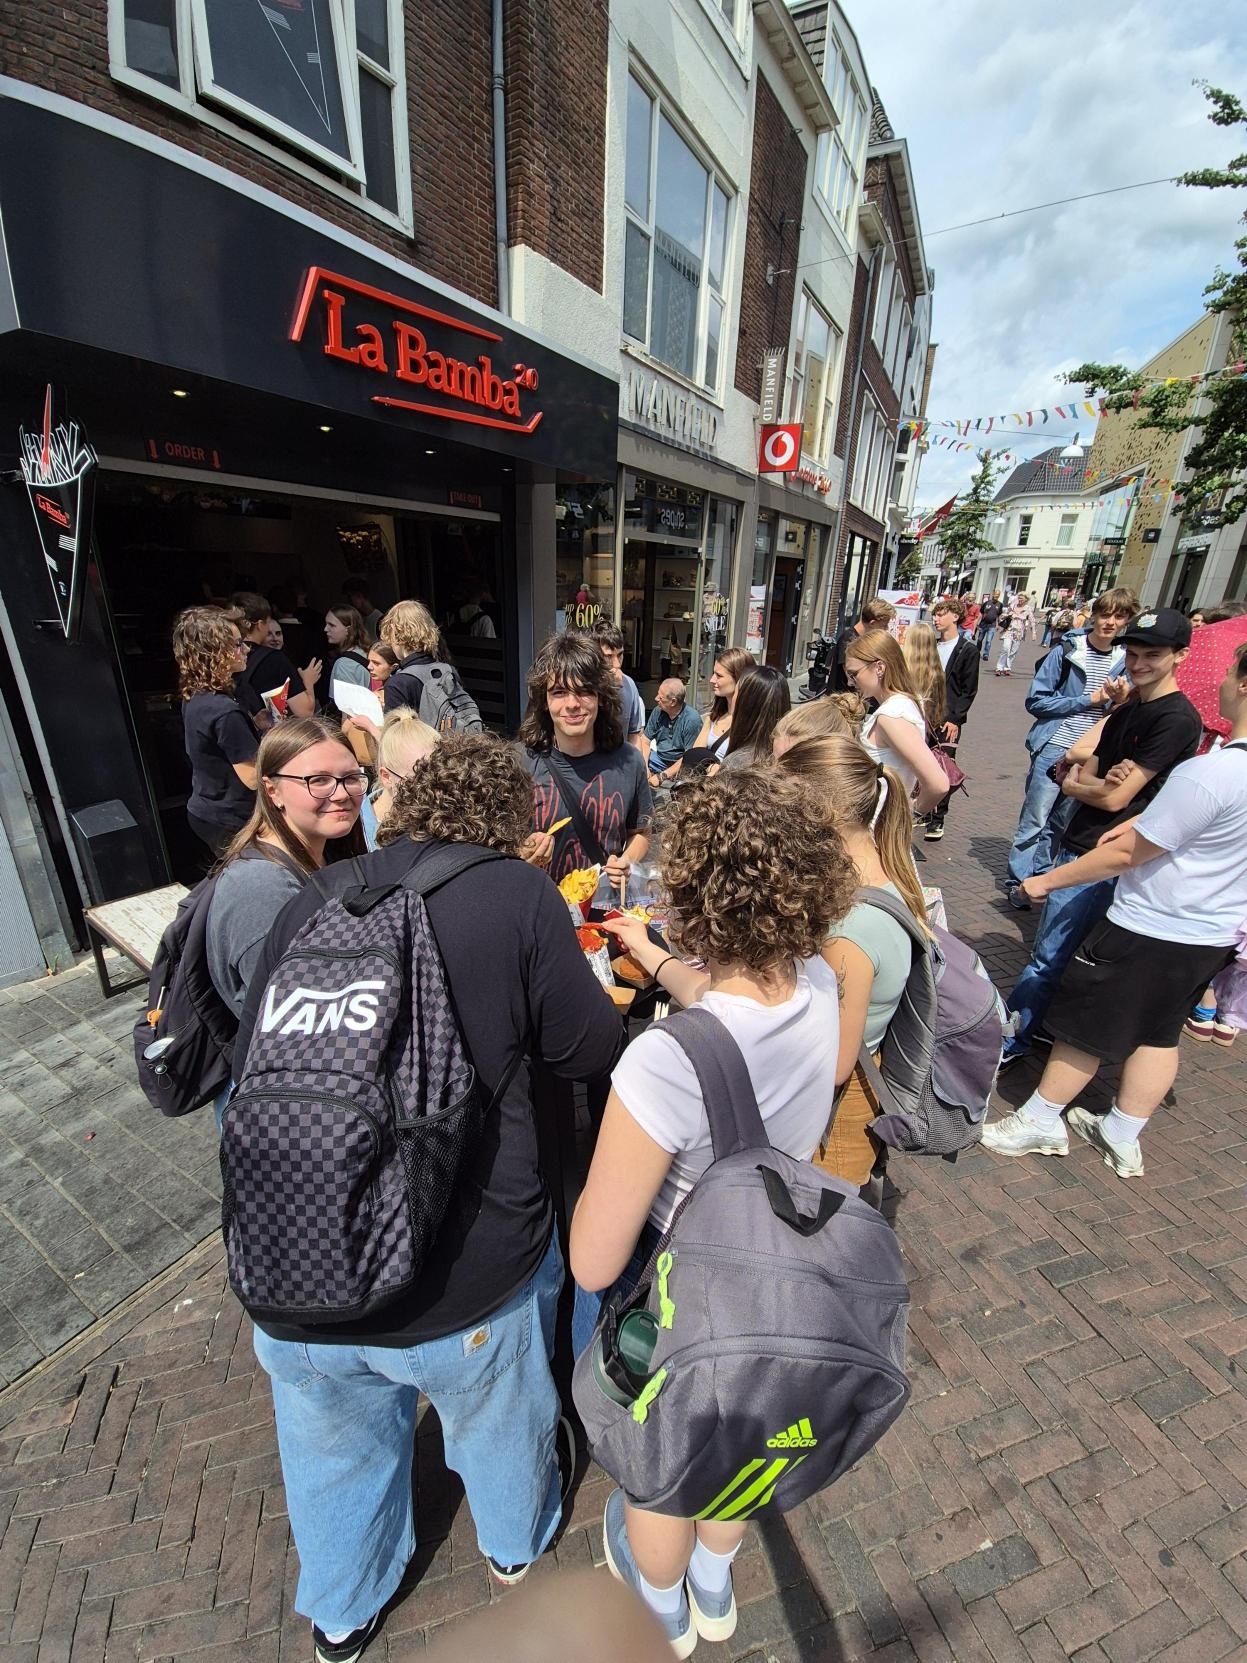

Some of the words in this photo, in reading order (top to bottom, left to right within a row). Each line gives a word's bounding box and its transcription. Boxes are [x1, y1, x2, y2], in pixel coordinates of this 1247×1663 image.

[323, 289, 389, 373] La
[392, 320, 522, 417] Bamba
[511, 363, 540, 391] 20
[628, 368, 718, 447] MANFIELD
[762, 358, 778, 421] MANFIELD
[164, 442, 206, 461] ORDER
[703, 616, 726, 633] SALE
[260, 980, 386, 1035] VANS
[766, 1436, 818, 1448] adidas
